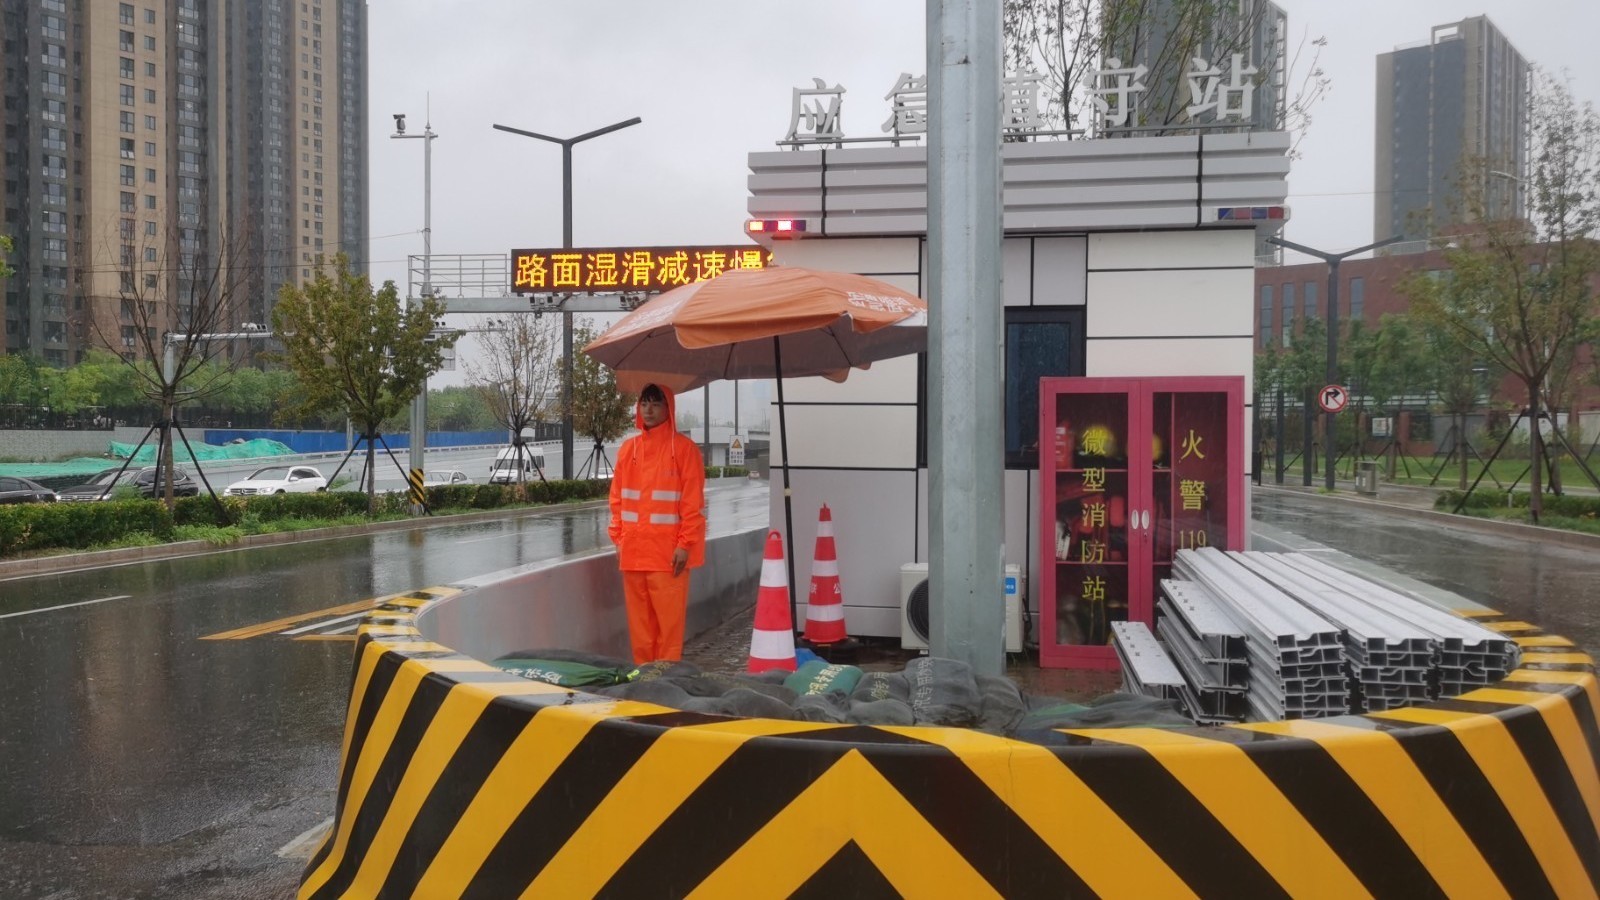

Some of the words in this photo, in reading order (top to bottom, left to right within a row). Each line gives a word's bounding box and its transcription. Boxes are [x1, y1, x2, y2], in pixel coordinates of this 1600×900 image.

[515, 250, 774, 287] 路面湿滑减速慢
[1180, 429, 1205, 510] 火警
[1082, 430, 1107, 600] 微型消防站
[1179, 529, 1207, 551] 119
